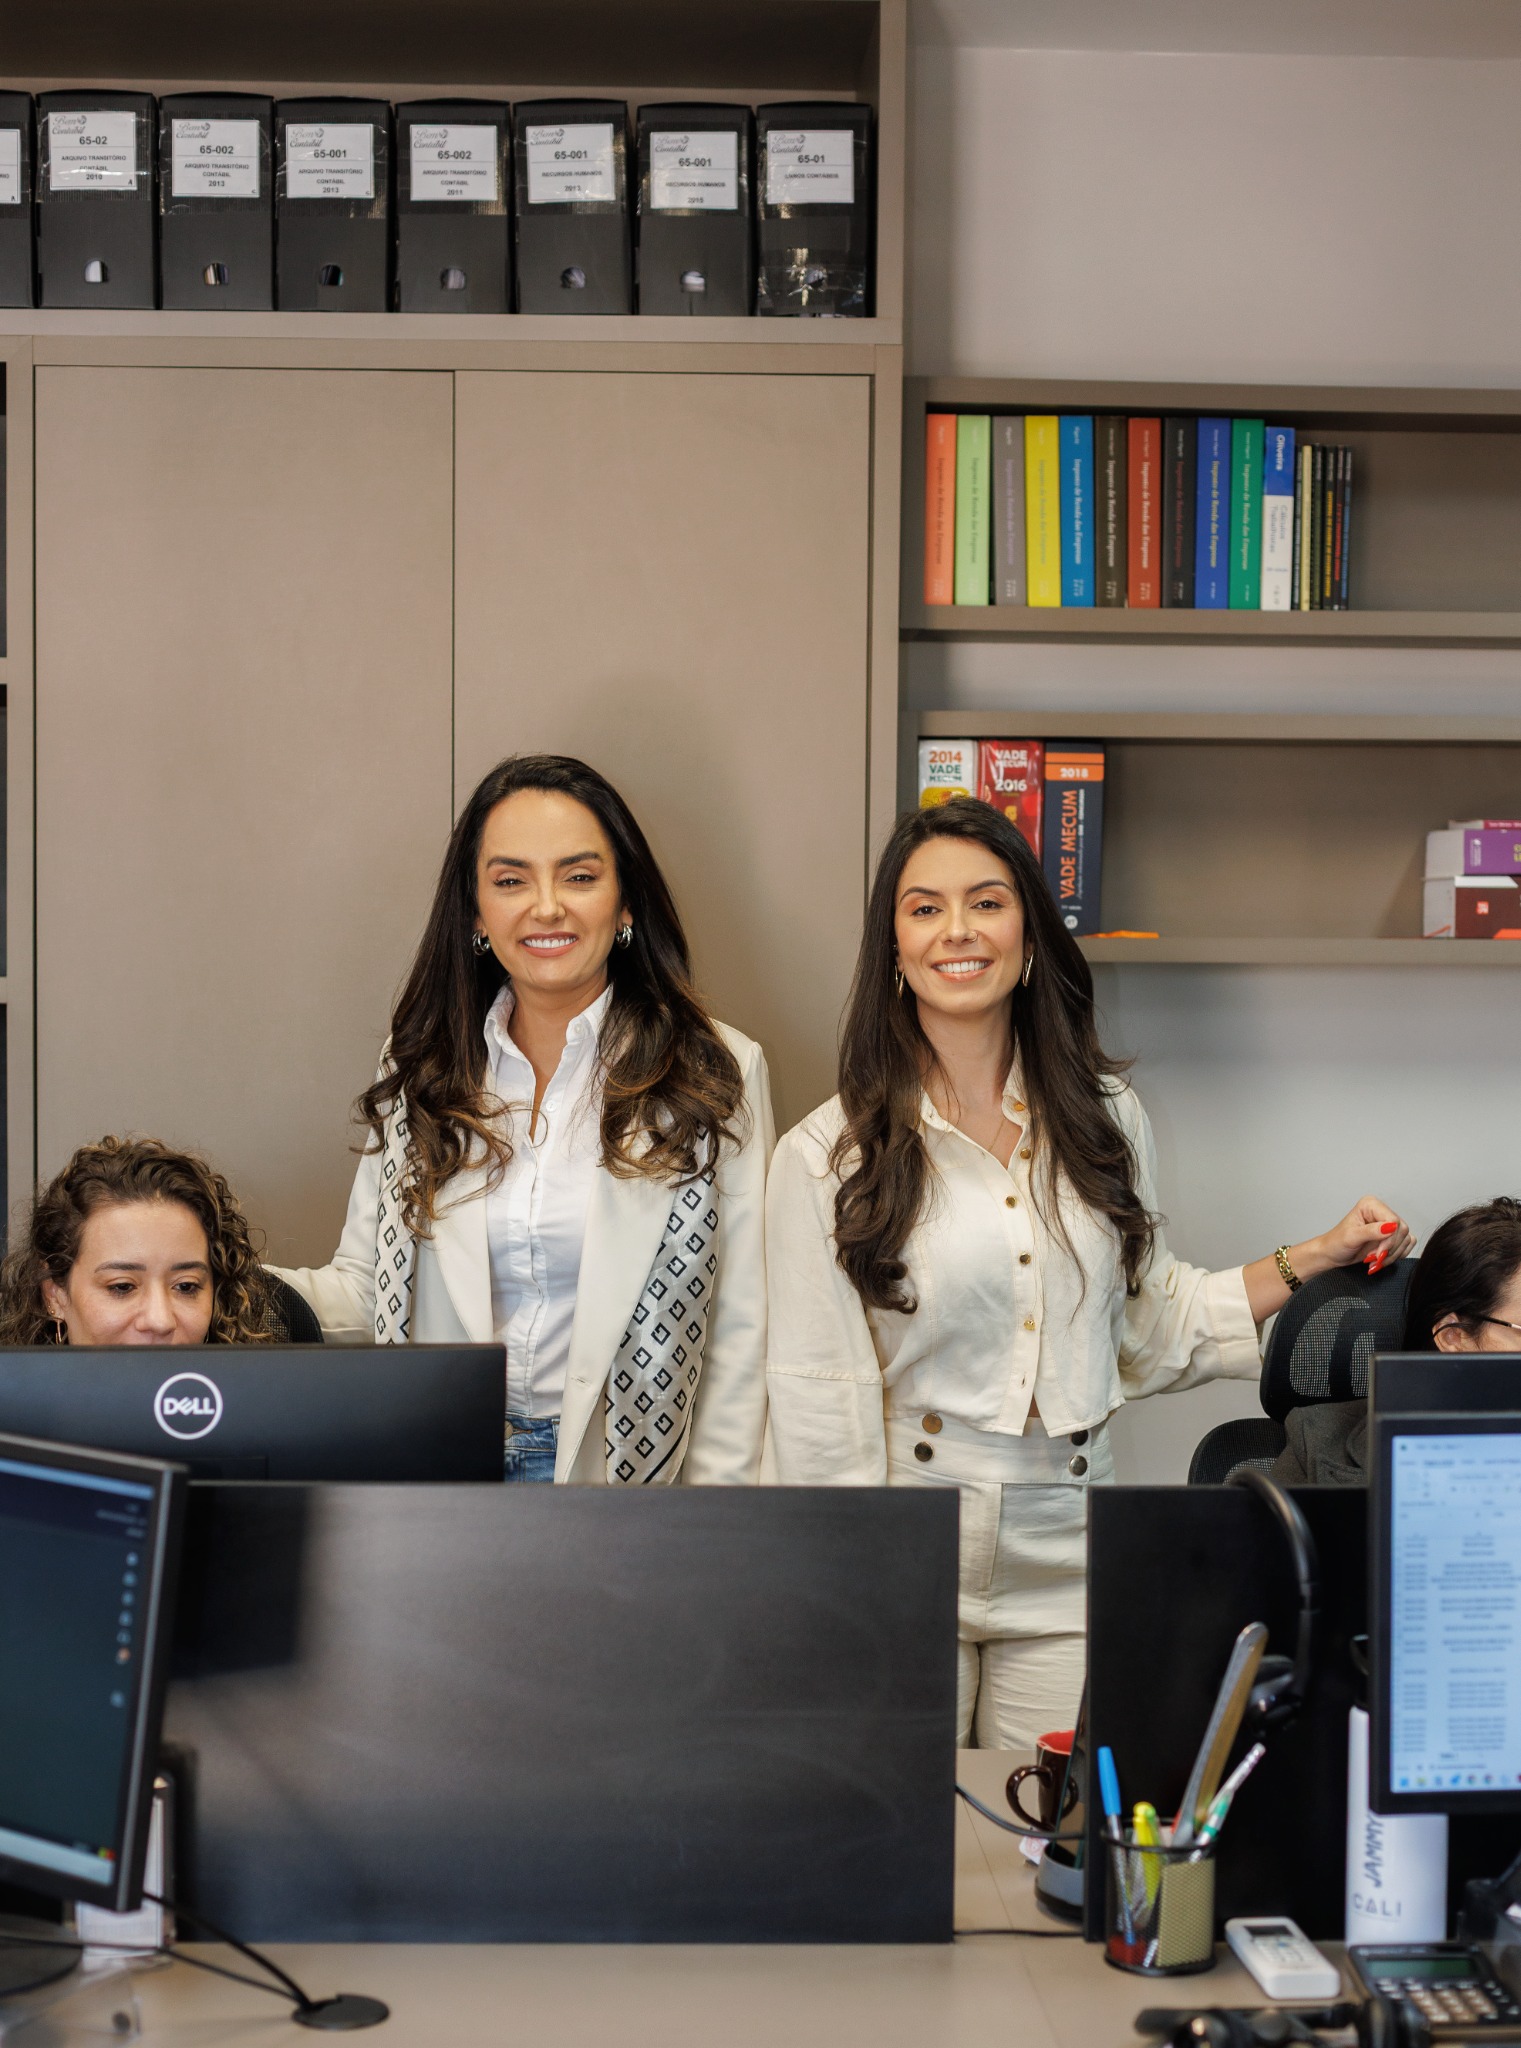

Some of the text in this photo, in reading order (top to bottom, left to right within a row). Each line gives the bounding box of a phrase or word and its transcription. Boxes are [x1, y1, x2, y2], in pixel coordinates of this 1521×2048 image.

[79, 136, 108, 145] 65-02
[200, 145, 234, 154] 65-002
[314, 150, 347, 158] 65-001
[438, 151, 472, 160] 65-002
[554, 150, 588, 159] 65-001
[678, 158, 712, 167] 65-001
[798, 155, 825, 163] 65-01
[1275, 434, 1286, 471] Oliveira
[1073, 459, 1082, 486] Imposto
[1107, 460, 1116, 488] Imposto
[1141, 462, 1150, 489] Imposto
[1210, 460, 1219, 488] Imposto
[1242, 463, 1251, 491] Imposto
[929, 751, 962, 763] 2014
[996, 750, 1028, 760] VADE
[929, 765, 961, 774] VADE
[1060, 768, 1088, 778] 2018
[995, 779, 1027, 792] 2016
[1061, 790, 1078, 851] MECUM
[1060, 856, 1076, 899] VADE
[163, 1396, 215, 1415] DELL
